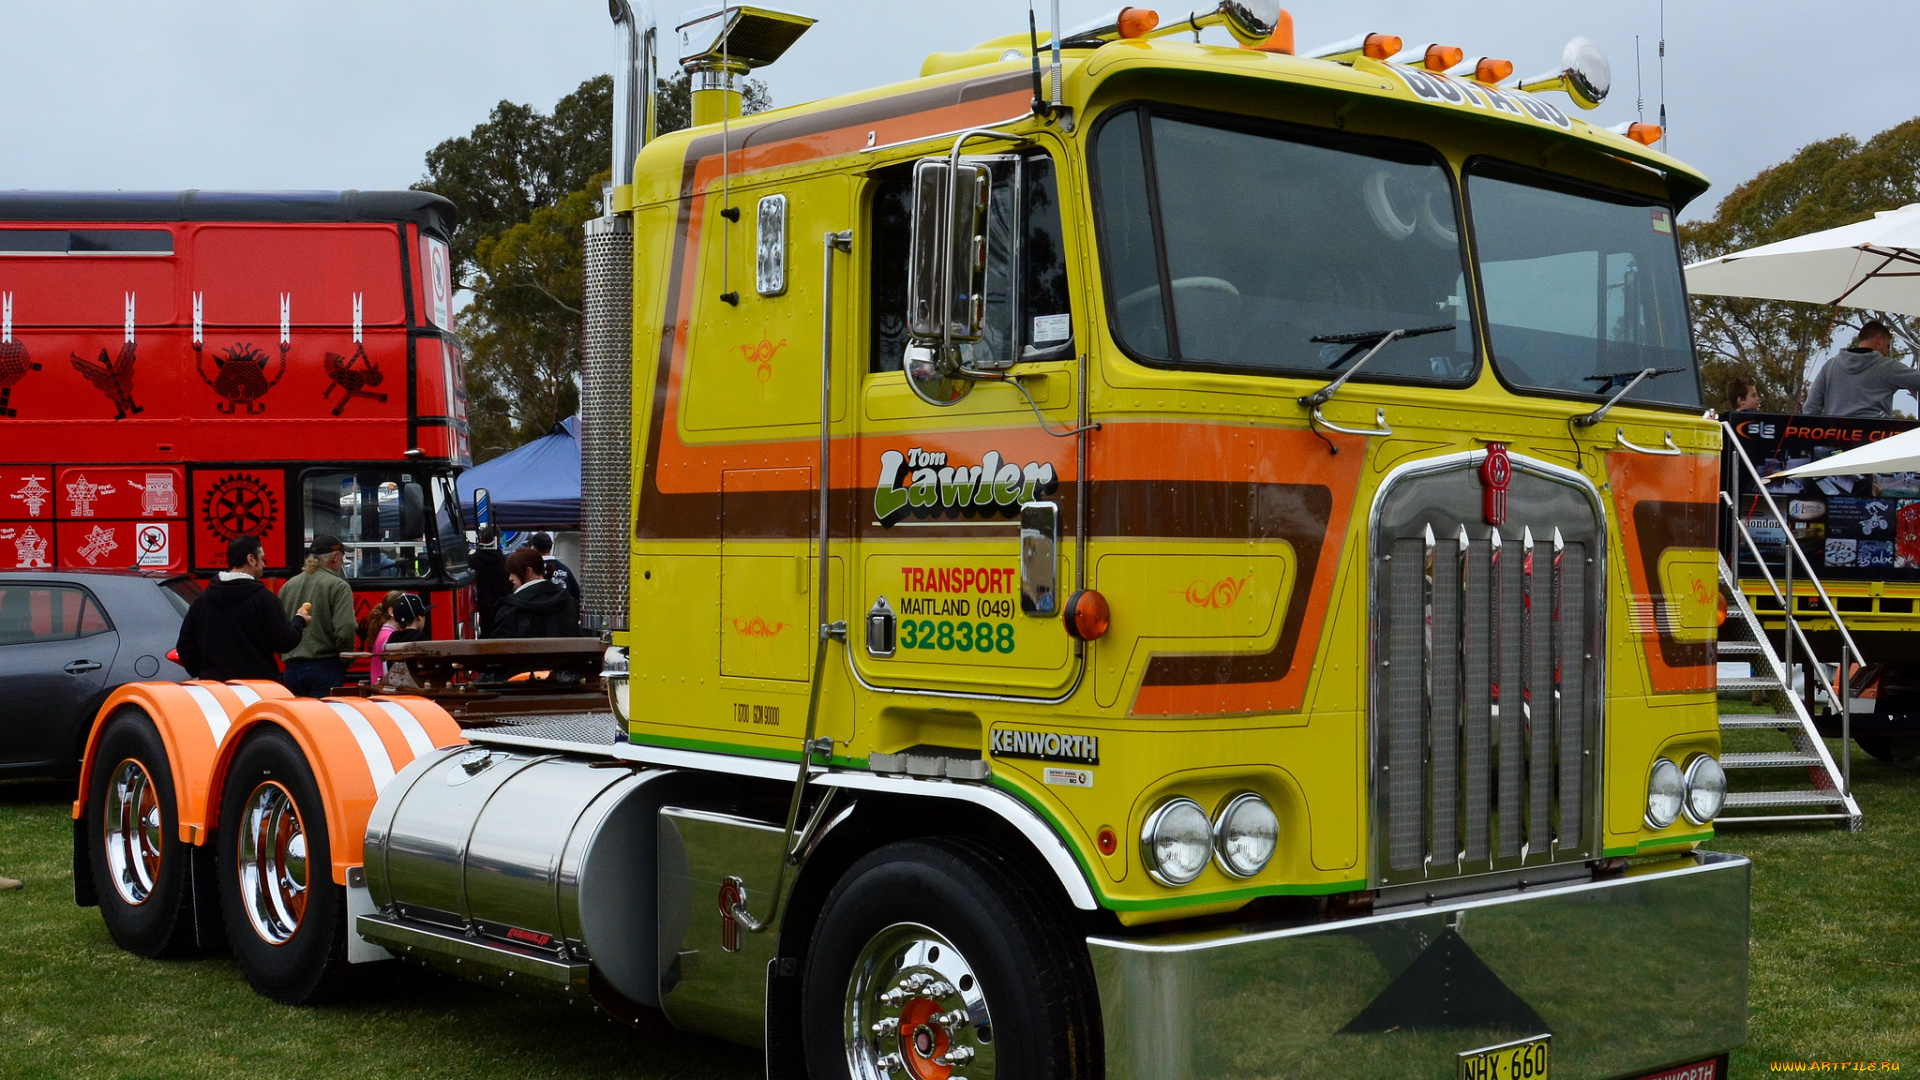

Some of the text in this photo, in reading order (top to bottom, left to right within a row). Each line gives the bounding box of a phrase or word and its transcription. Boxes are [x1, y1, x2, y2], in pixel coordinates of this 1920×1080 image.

[1784, 427, 1903, 443] PROFILE CU
[908, 448, 947, 468] Tom
[874, 450, 1055, 521] Lawler
[901, 567, 1016, 594] TRANSPORT
[900, 597, 1016, 620] MAITLAND (049)
[900, 619, 1016, 654] 328388
[991, 729, 1098, 760] KENWORTH
